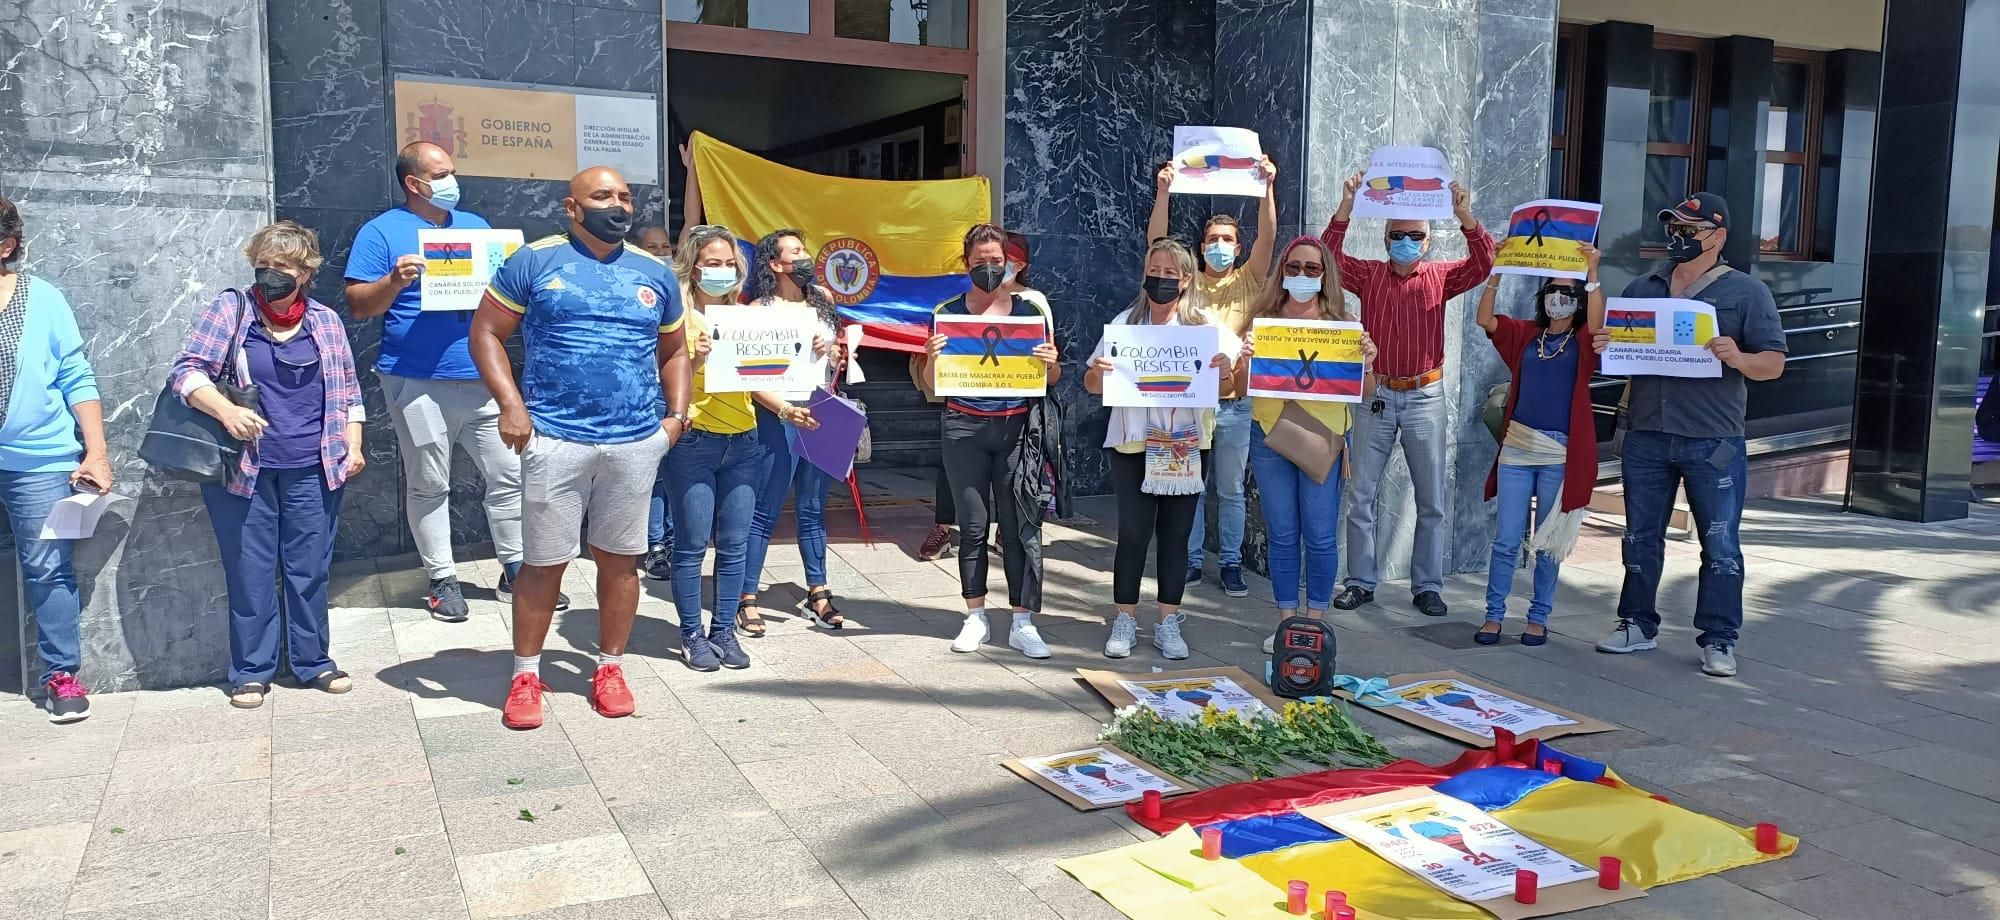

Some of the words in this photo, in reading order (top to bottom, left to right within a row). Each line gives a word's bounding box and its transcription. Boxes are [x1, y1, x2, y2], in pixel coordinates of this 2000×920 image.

[481, 118, 552, 133] GOBIERNO
[481, 135, 498, 146] DE
[502, 136, 553, 149] ESPAÑA
[818, 240, 877, 269] REPUBLICA
[1558, 255, 1585, 263] PUEBLO
[831, 279, 876, 304] OLOMBIA
[1664, 356, 1713, 364] COLOMBIANO
[1470, 822, 1497, 832] 672
[1463, 852, 1497, 866] 21
